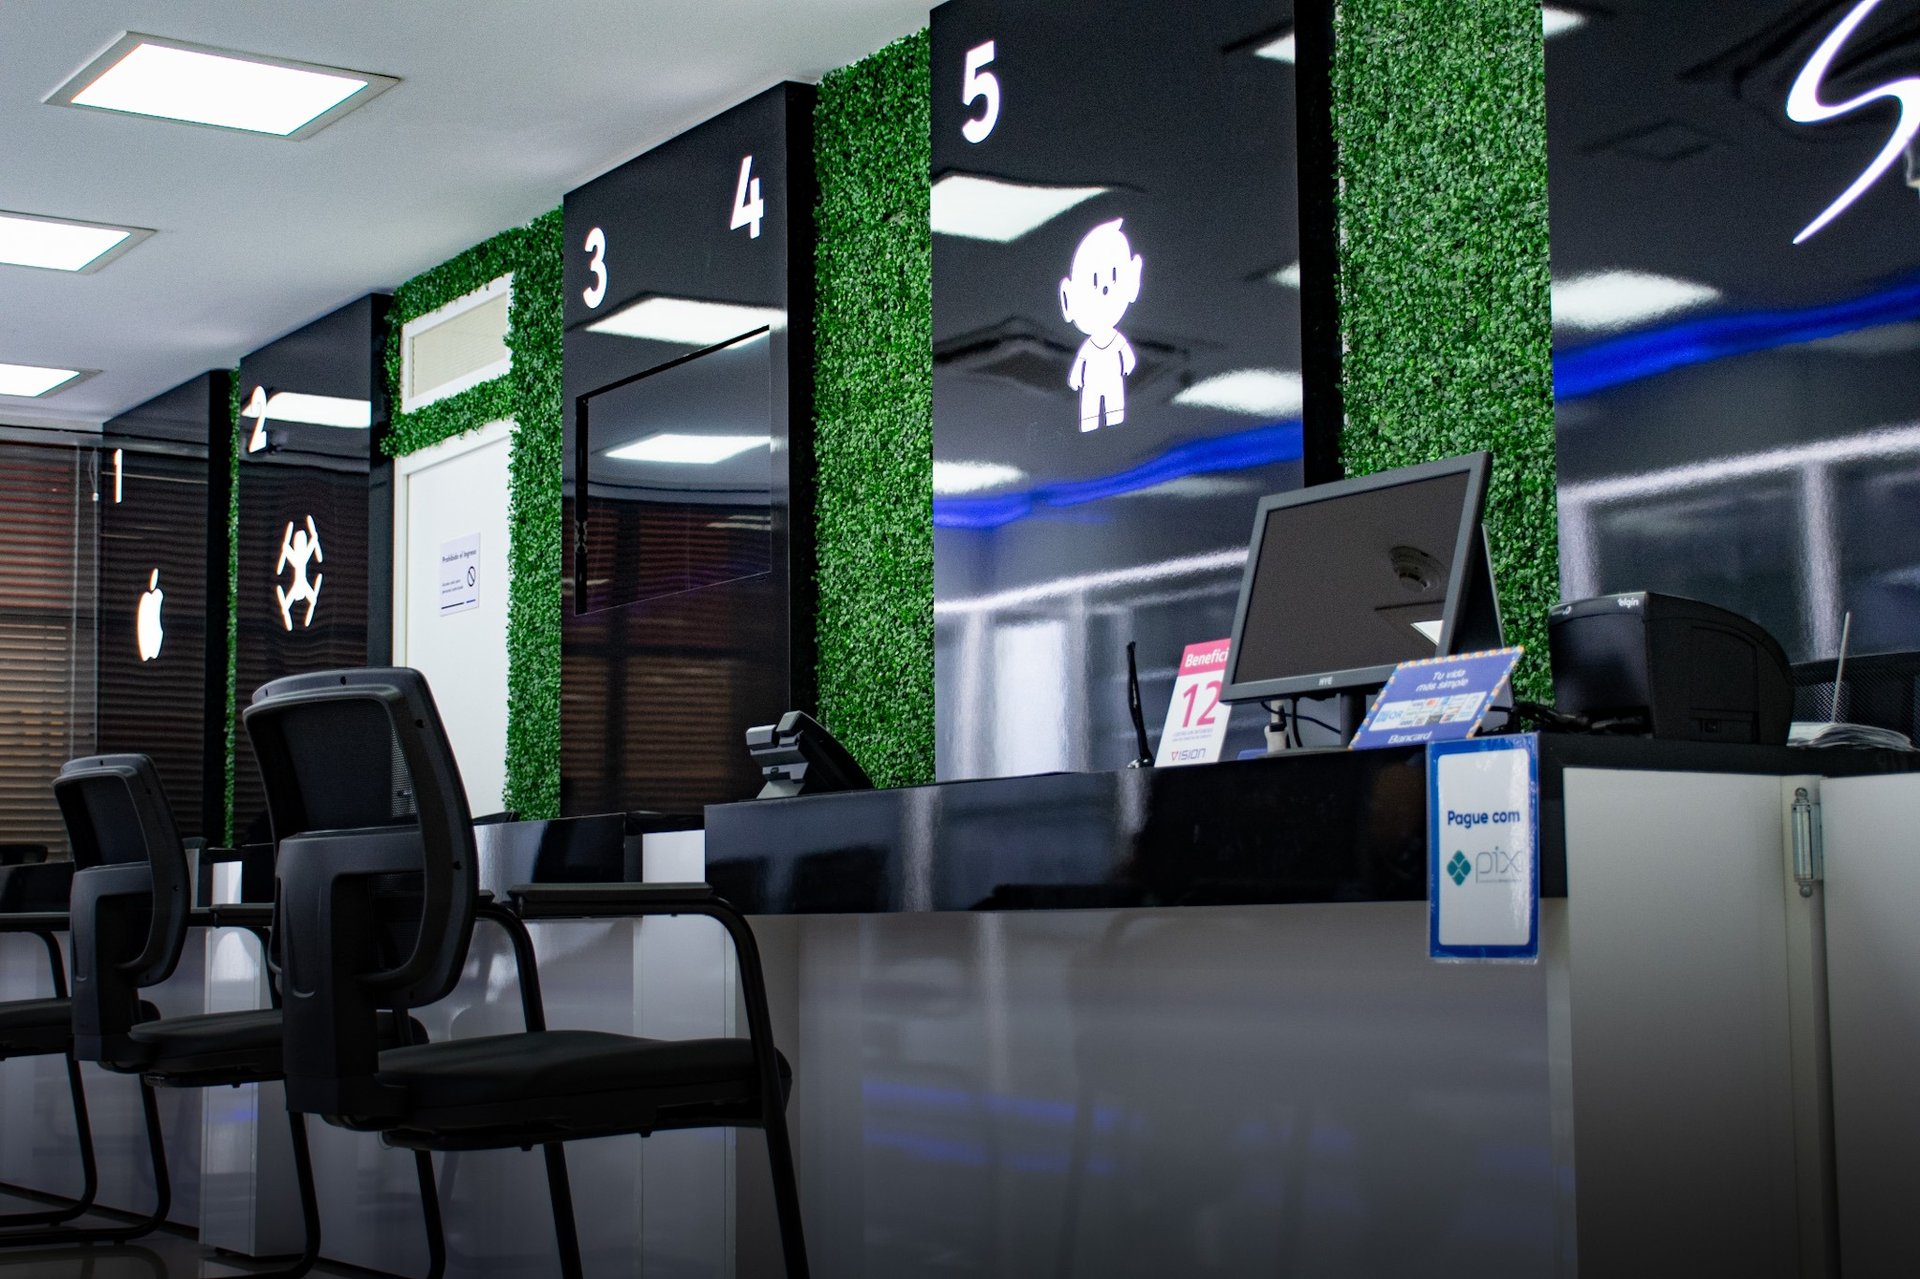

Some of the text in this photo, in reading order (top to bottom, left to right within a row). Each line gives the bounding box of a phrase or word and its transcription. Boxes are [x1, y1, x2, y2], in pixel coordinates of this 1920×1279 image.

[962, 40, 1000, 144] 5
[730, 155, 764, 239] 4
[583, 227, 607, 309] 3
[250, 385, 267, 453] 2
[114, 448, 122, 504] 1
[1433, 669, 1466, 680] Tu vida
[1437, 678, 1469, 689] simple
[1182, 680, 1222, 728] 12
[1387, 731, 1433, 744] Bancard
[1447, 810, 1520, 829] Pague com
[1475, 846, 1522, 883] pix
